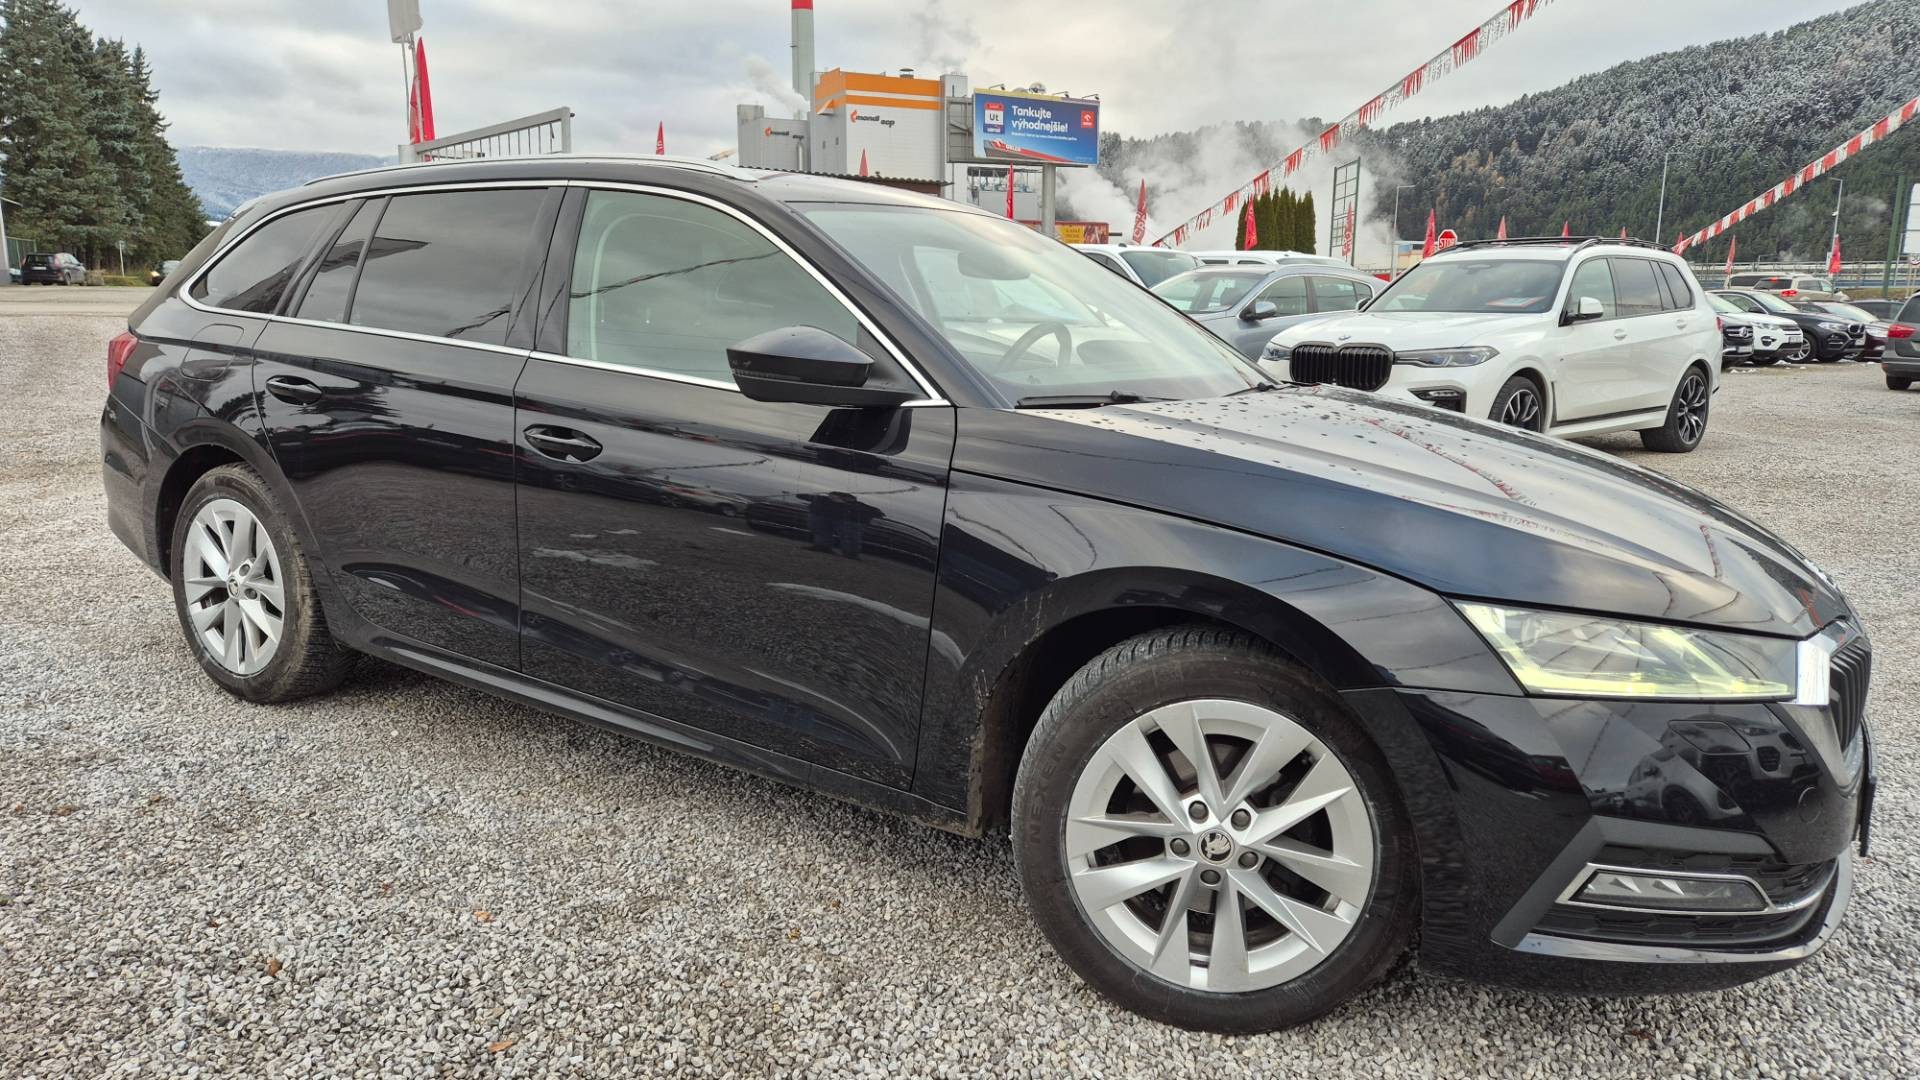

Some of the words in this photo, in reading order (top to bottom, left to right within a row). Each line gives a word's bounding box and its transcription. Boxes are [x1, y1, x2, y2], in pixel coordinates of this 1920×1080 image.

[1011, 105, 1052, 120] Tankujte
[1011, 118, 1068, 133] výhodnejšie!
[1439, 237, 1457, 249] STOP
